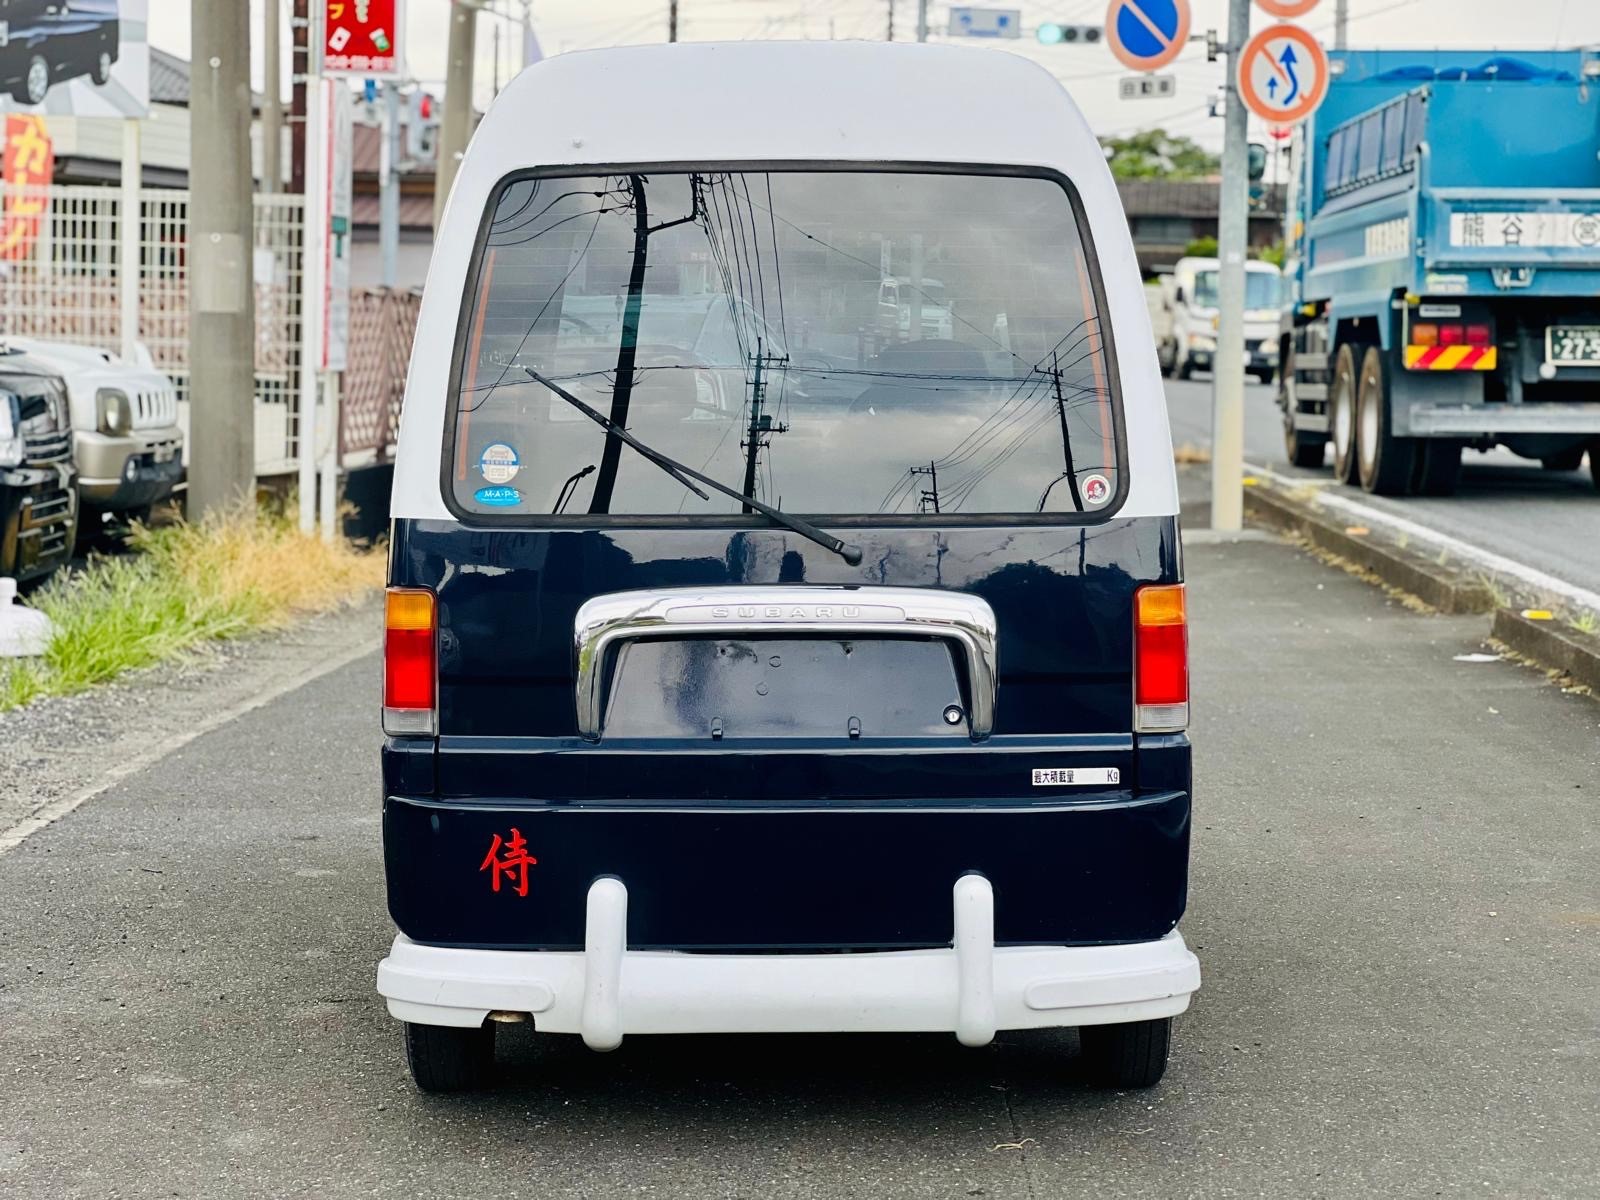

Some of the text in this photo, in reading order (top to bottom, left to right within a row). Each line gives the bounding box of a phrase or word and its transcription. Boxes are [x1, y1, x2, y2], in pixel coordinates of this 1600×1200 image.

[712, 607, 861, 618] SUBARU
[1034, 769, 1119, 783] 最大積載量 Kg
[479, 827, 538, 897] 侍
